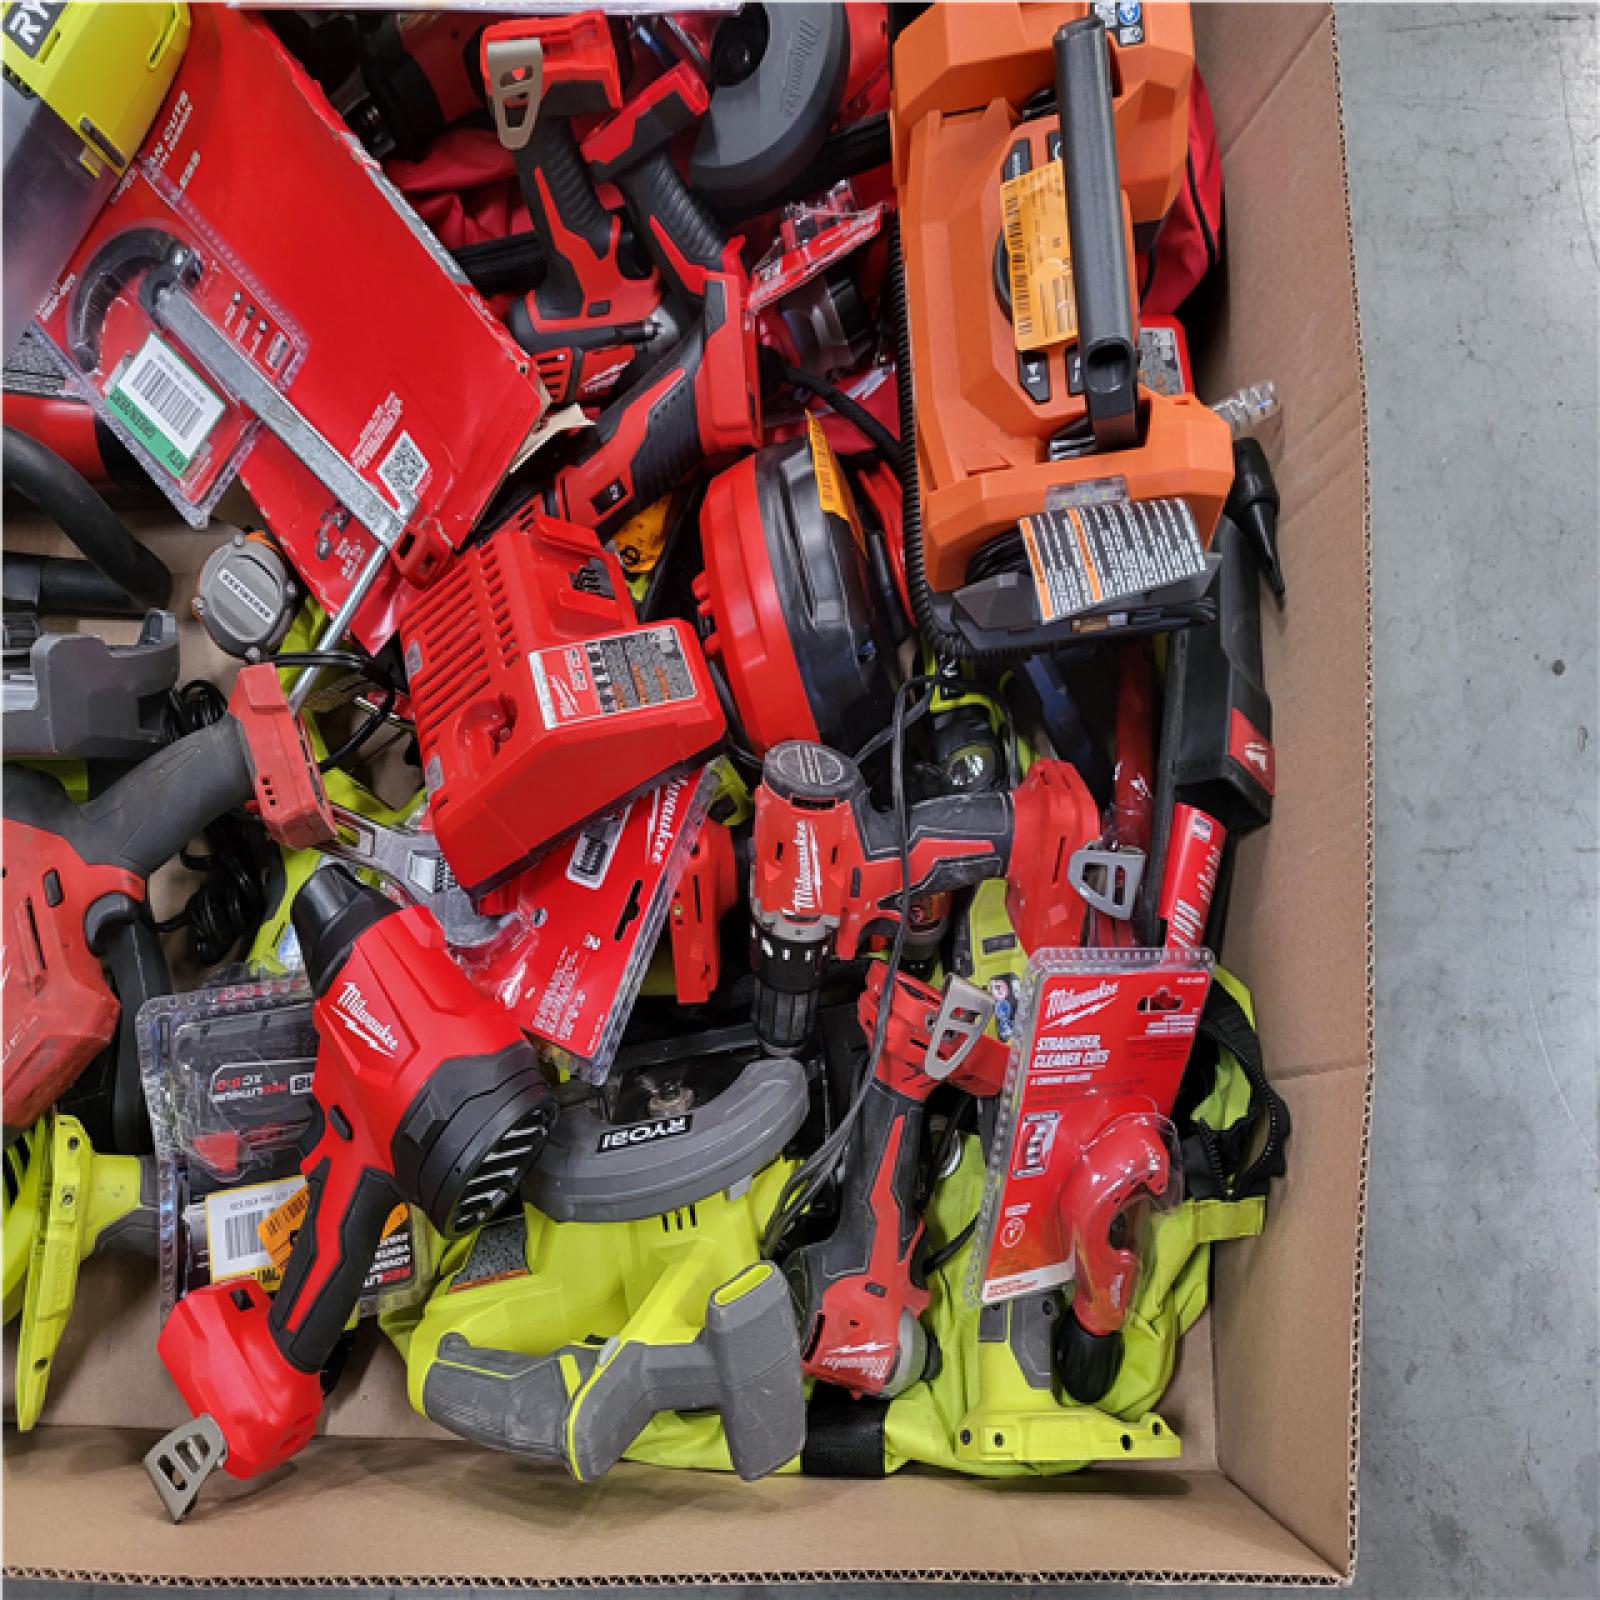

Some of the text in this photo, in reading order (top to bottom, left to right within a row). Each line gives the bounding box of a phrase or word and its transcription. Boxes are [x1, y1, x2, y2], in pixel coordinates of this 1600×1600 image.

[792, 818, 815, 912] Milwaukee
[337, 982, 399, 1052] Milwaukee
[1045, 979, 1120, 1019] Milwaukee
[1032, 1052, 1082, 1069] CLEANER
[602, 1116, 687, 1150] RYOBI
[822, 1355, 890, 1381] Milwaukee
